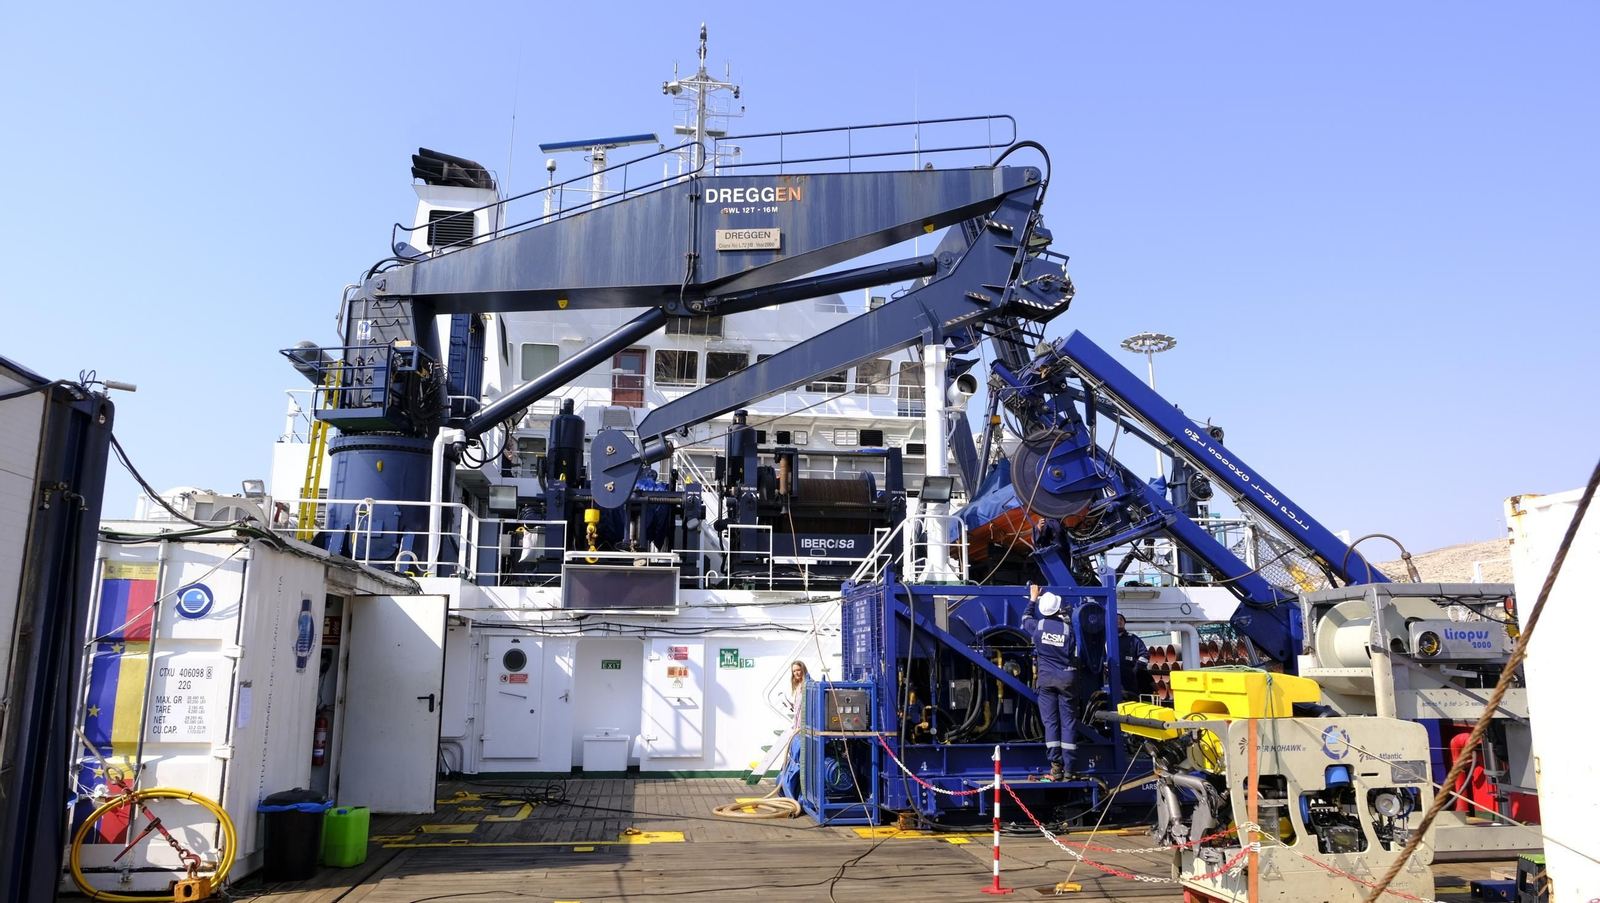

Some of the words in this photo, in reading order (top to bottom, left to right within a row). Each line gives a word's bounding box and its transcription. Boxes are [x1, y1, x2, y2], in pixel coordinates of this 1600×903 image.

[705, 186, 802, 203] DREGGEN
[724, 231, 771, 240] DREGGEN
[1251, 483, 1280, 507] LINE
[1280, 506, 1310, 531] PULL
[1041, 631, 1065, 643] ACSM
[1444, 628, 1489, 642] Liropus
[1472, 641, 1492, 649] 2000
[159, 667, 175, 677] CTXU
[179, 668, 204, 678] 406098
[178, 680, 192, 690] 22G
[173, 695, 183, 704] GR
[155, 705, 171, 714] TARE
[153, 715, 167, 724] NET
[1271, 744, 1302, 752] MOHAWK
[1088, 758, 1096, 769] 5
